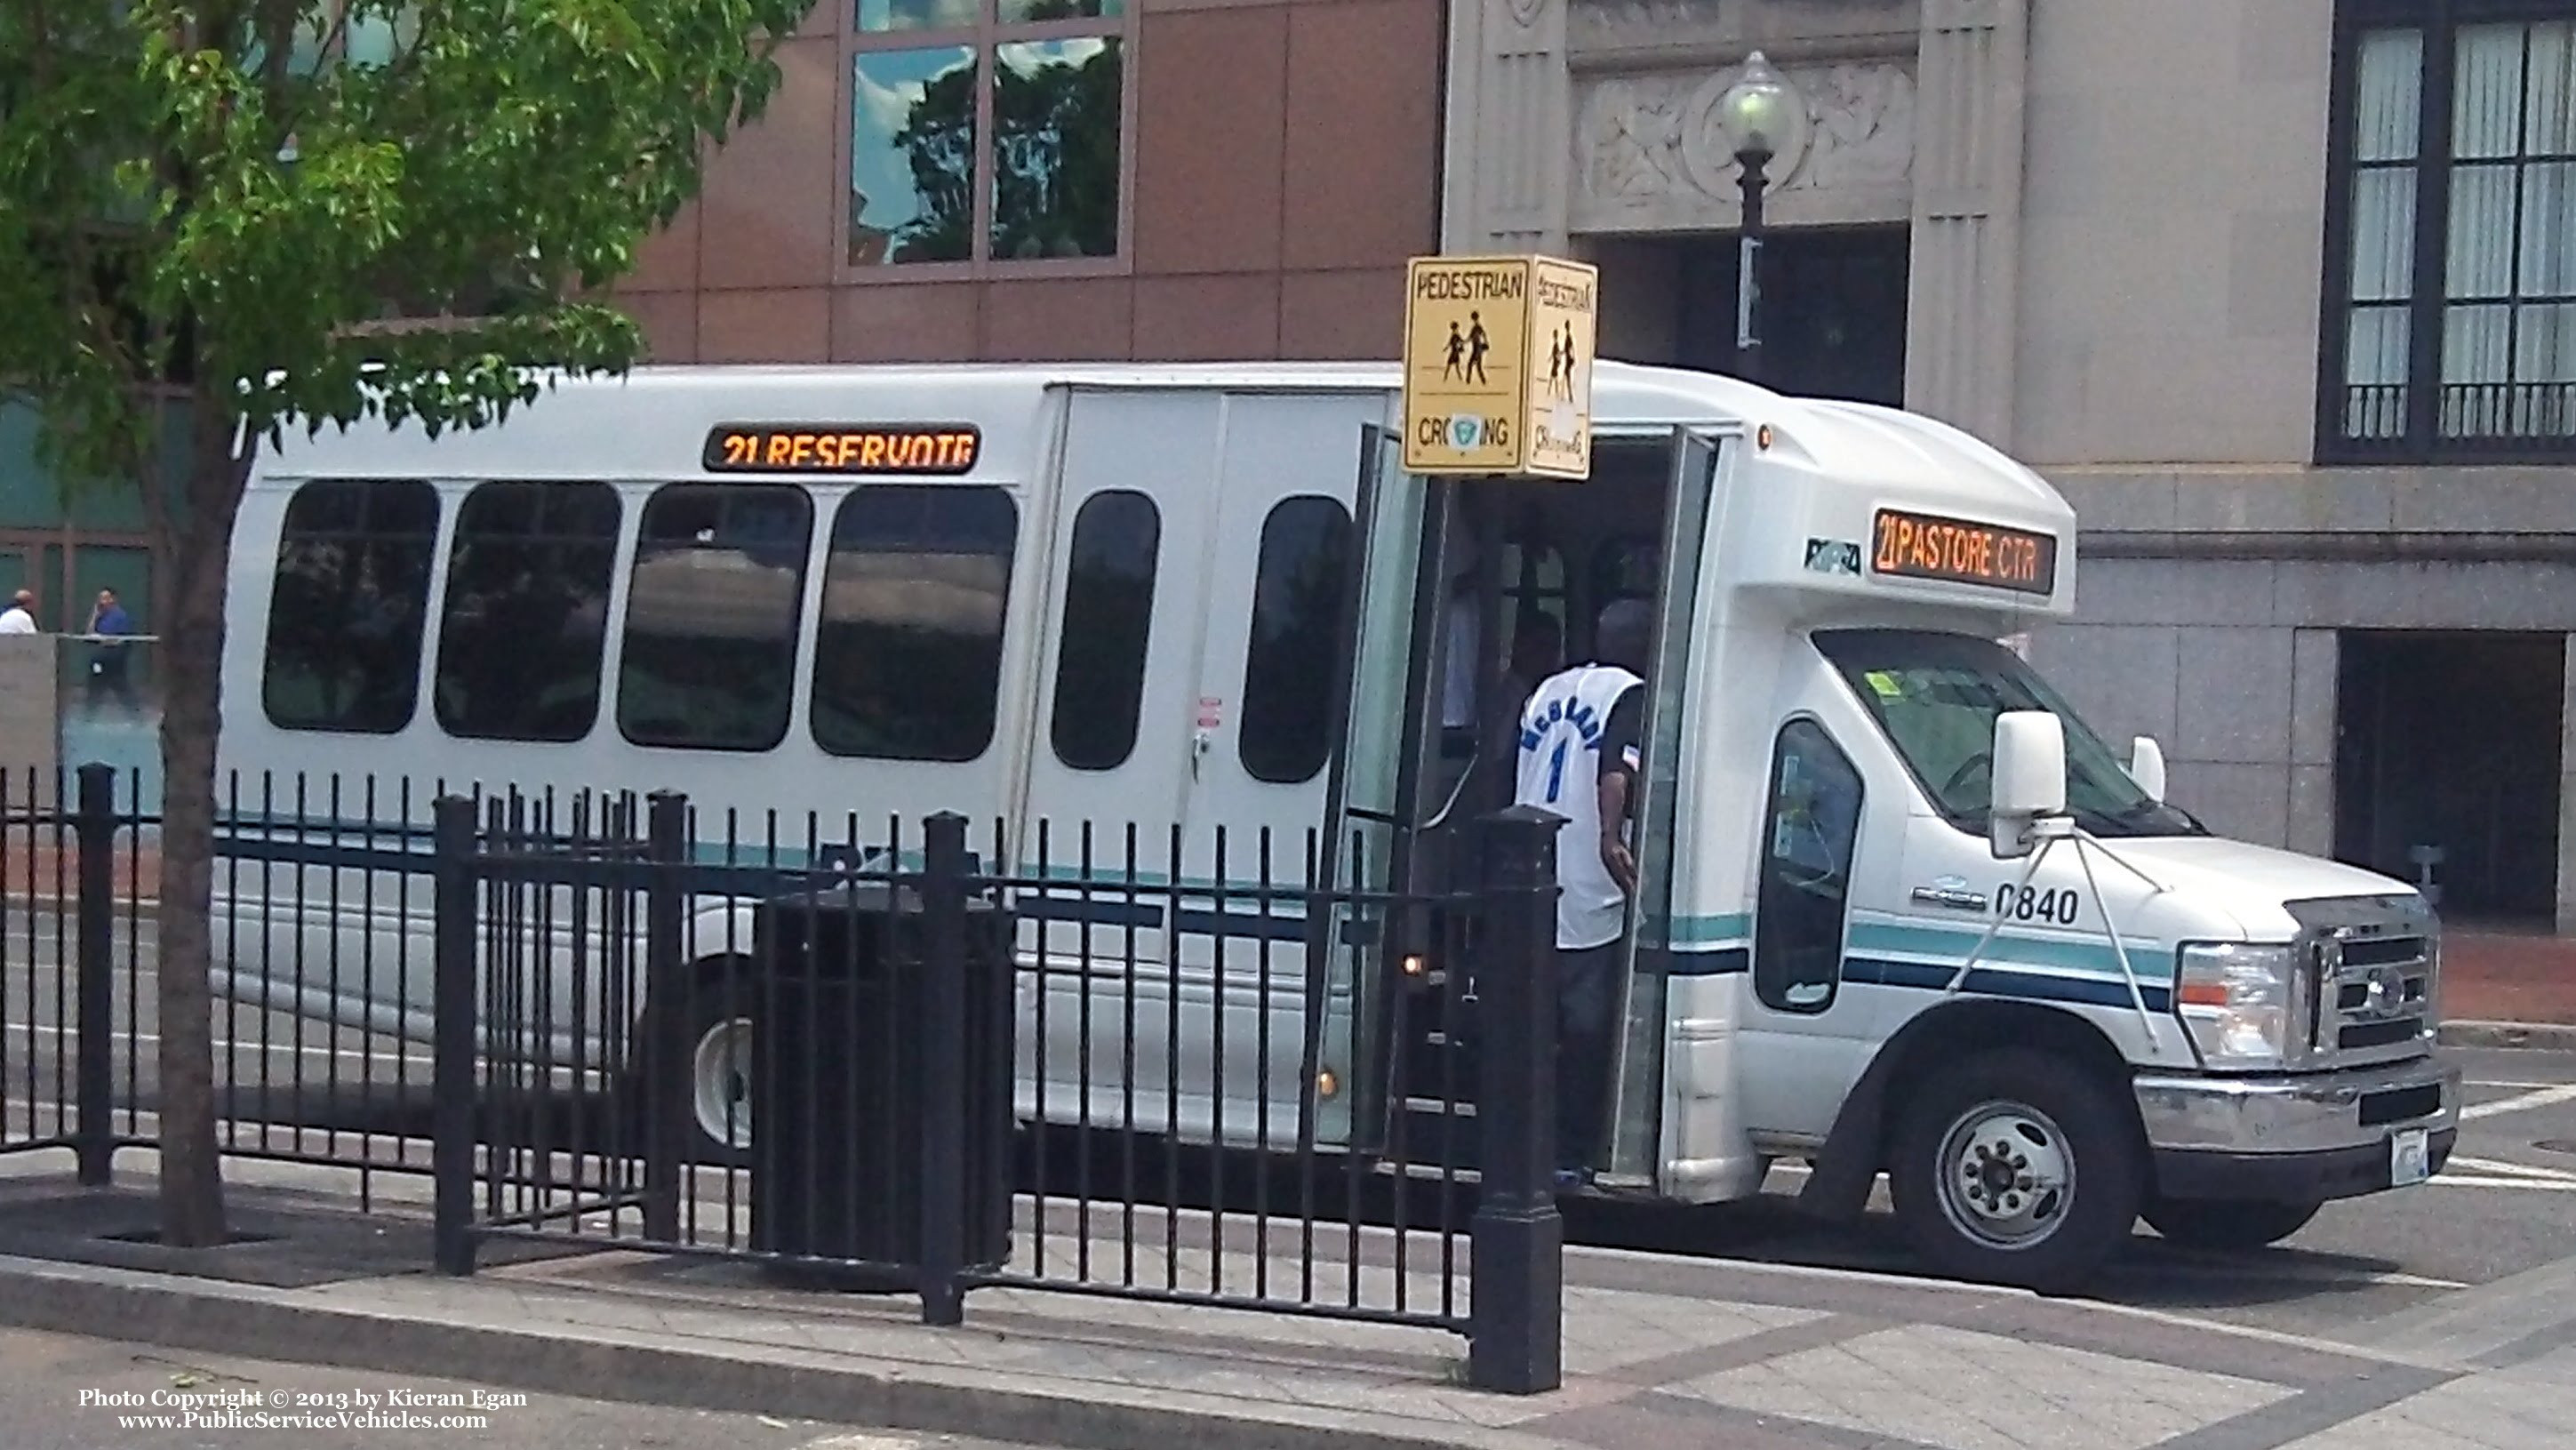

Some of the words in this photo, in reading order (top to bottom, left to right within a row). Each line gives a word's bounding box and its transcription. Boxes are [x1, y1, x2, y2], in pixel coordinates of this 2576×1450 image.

[1417, 271, 1523, 300] PEDESTRIAN
[1897, 519, 1992, 576] PASTORE
[1998, 536, 2036, 581] CTR
[1547, 737, 1567, 803] 1
[1996, 883, 2078, 925] 0840
